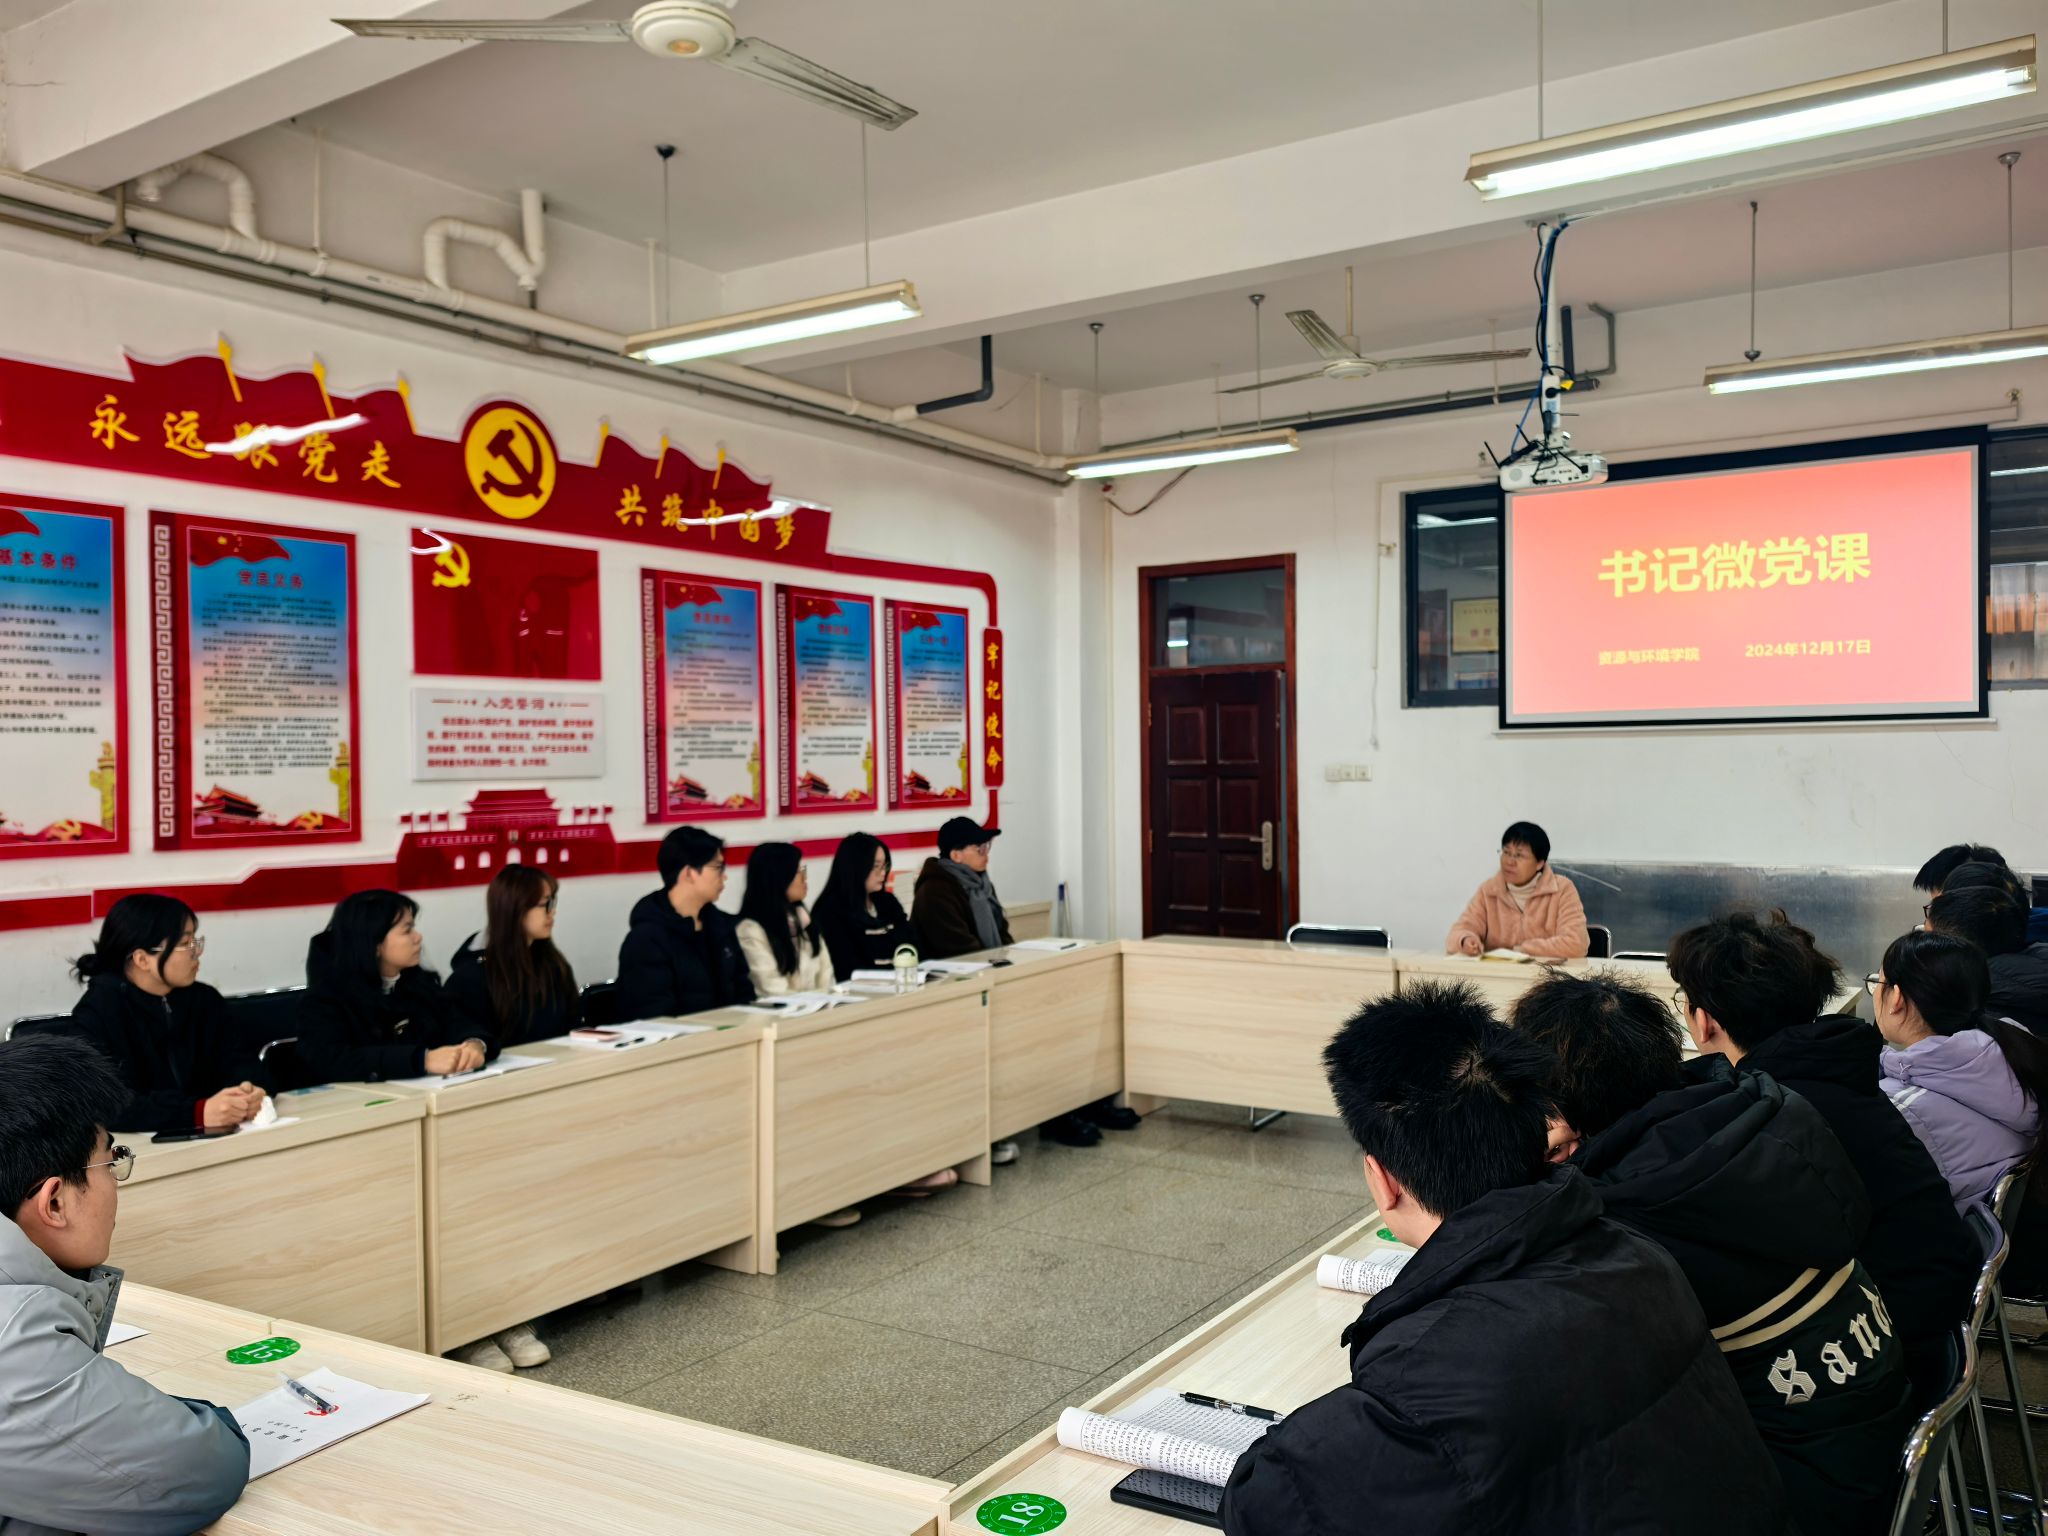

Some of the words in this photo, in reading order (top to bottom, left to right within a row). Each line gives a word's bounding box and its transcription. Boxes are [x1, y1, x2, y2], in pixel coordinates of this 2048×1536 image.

[1597, 532, 1872, 599] 书记微党课
[1599, 647, 1701, 666] 资源与环境学院
[1745, 639, 1872, 658] 2024年12月17日
[985, 641, 1002, 774] 牢记使命
[998, 1501, 1045, 1528] 18
